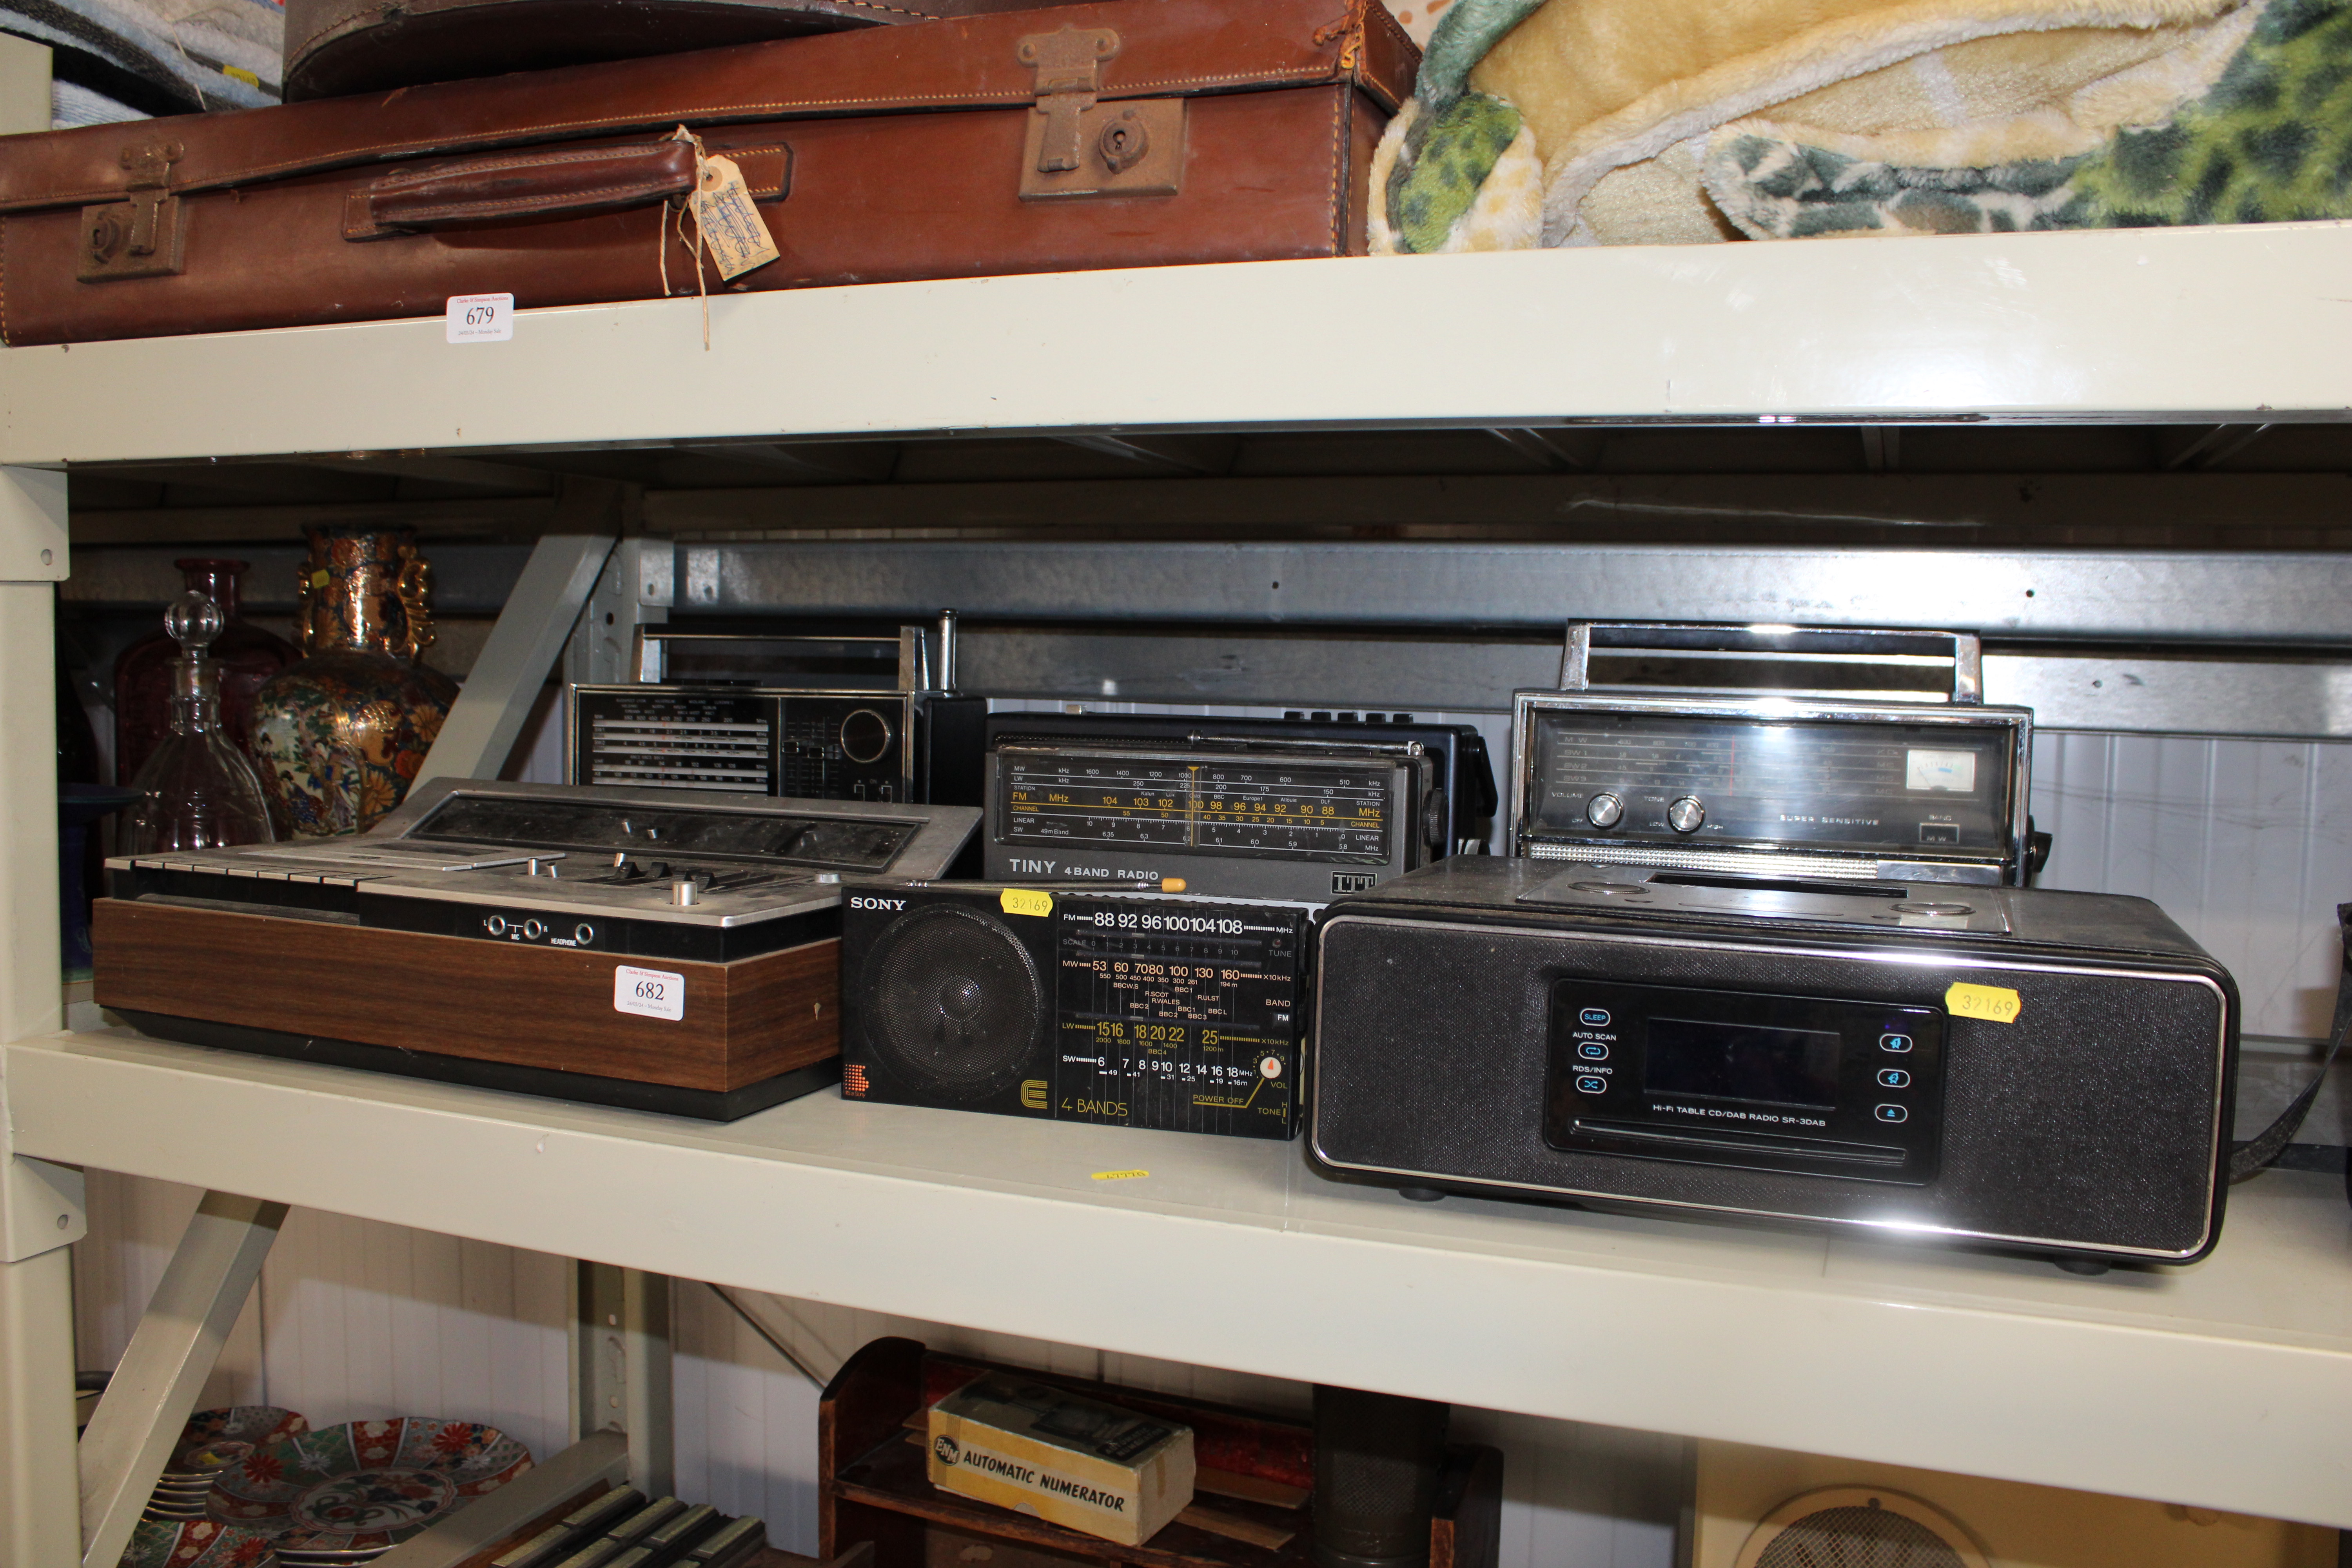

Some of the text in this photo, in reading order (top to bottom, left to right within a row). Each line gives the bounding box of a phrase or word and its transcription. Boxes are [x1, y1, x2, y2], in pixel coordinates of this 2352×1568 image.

[466, 307, 495, 325] 679
[1013, 792, 1027, 800] FM
[1049, 794, 1069, 802] MHz
[1133, 798, 1149, 806] 103
[1158, 799, 1173, 808] 102
[1210, 801, 1222, 810] 98
[1234, 802, 1246, 811] 96
[1254, 803, 1266, 811] 94
[1274, 804, 1286, 813] 92
[1300, 805, 1313, 814] 90
[1322, 806, 1334, 815] 88
[1359, 808, 1380, 817] MHz
[1822, 817, 1880, 826] SENSITIVE
[1009, 858, 1056, 874] TINY
[1118, 869, 1158, 880] RADIO
[1334, 874, 1374, 893] ITT
[851, 897, 906, 911] SONY
[1012, 897, 1048, 912] 32169
[1094, 912, 1115, 927] 88
[1118, 913, 1137, 928] 92
[1142, 915, 1162, 929] 96
[1163, 916, 1190, 931] 100
[1190, 917, 1216, 933] 104
[1216, 919, 1243, 934] 108
[551, 938, 577, 946] HEADPHONE
[1093, 960, 1107, 971] 53
[1114, 962, 1129, 973] 60
[1135, 963, 1148, 974] 70
[1149, 964, 1164, 975] 80
[1169, 966, 1188, 977] 100
[1194, 967, 1213, 978] 130
[1221, 969, 1240, 980] 160
[635, 981, 664, 1001] 682
[1266, 999, 1291, 1007] BAND
[1962, 995, 2013, 1016] 32169
[1097, 1022, 1110, 1036] 15
[1111, 1023, 1123, 1037] 16
[1134, 1024, 1147, 1039] 18
[1150, 1025, 1166, 1040] 20
[1169, 1027, 1184, 1042] 22
[1202, 1029, 1218, 1045] 25
[1098, 1056, 1105, 1067] 6
[1122, 1058, 1129, 1069] 7
[1138, 1060, 1146, 1070] 8
[1152, 1061, 1159, 1071] 9
[1161, 1062, 1172, 1072] 10
[1179, 1063, 1190, 1074] 12
[1196, 1064, 1207, 1075] 14
[1211, 1065, 1223, 1076] 16
[1227, 1067, 1238, 1078] 18
[1573, 1065, 1613, 1074] RDS/INFO
[1061, 1098, 1128, 1116] 4 BANDS
[1193, 1094, 1224, 1103] POWER
[1258, 1107, 1281, 1116] TONE
[1653, 1104, 1826, 1127] Hi-Fi TABLE CD/DAB RADIO SR-3DAB
[935, 1438, 959, 1463] ENM
[963, 1450, 1125, 1512] AUTOMATIC NUMERATOR
